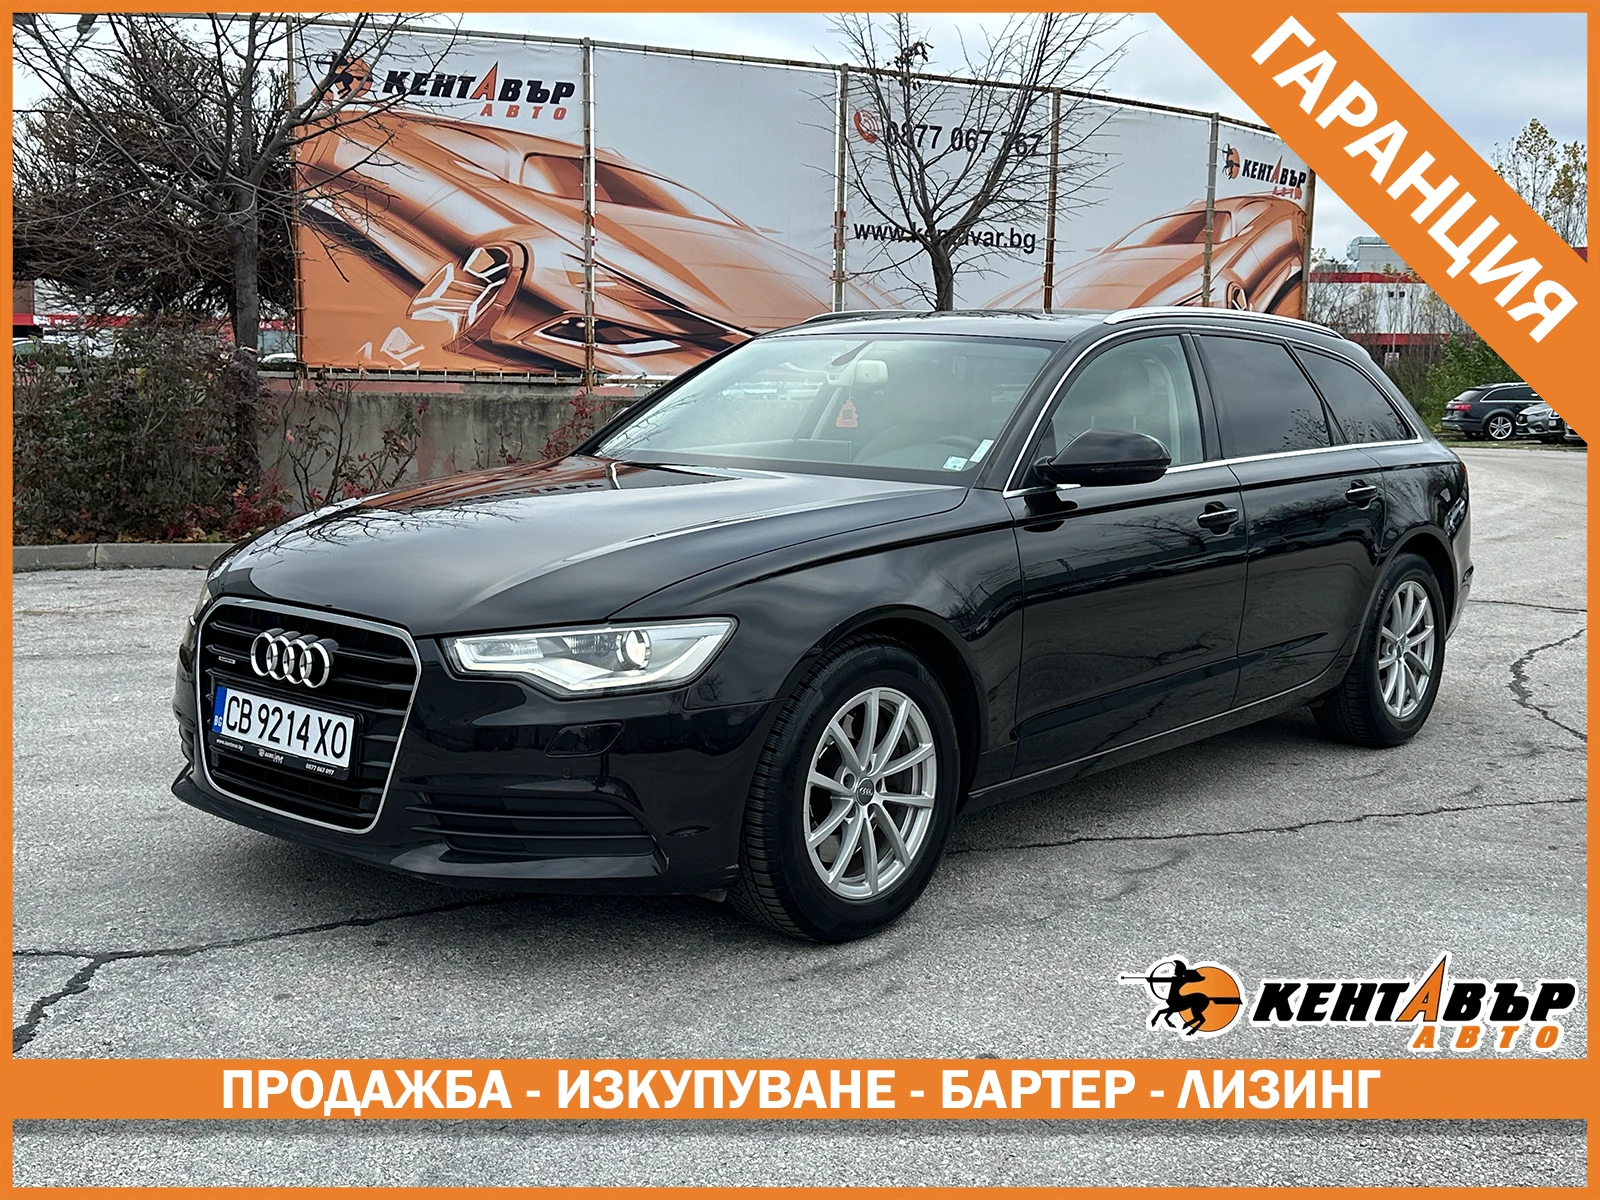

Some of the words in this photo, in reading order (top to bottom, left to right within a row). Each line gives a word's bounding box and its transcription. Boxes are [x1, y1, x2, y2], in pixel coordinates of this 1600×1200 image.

[382, 61, 576, 105] КЕНТАВЪР
[480, 103, 567, 121] АВТО
[951, 127, 994, 154] 067
[1241, 154, 1307, 188] КЕНТАВЪР
[213, 714, 223, 727] BG
[226, 696, 252, 733] CB
[258, 703, 309, 750] 9214
[314, 716, 347, 758] XO
